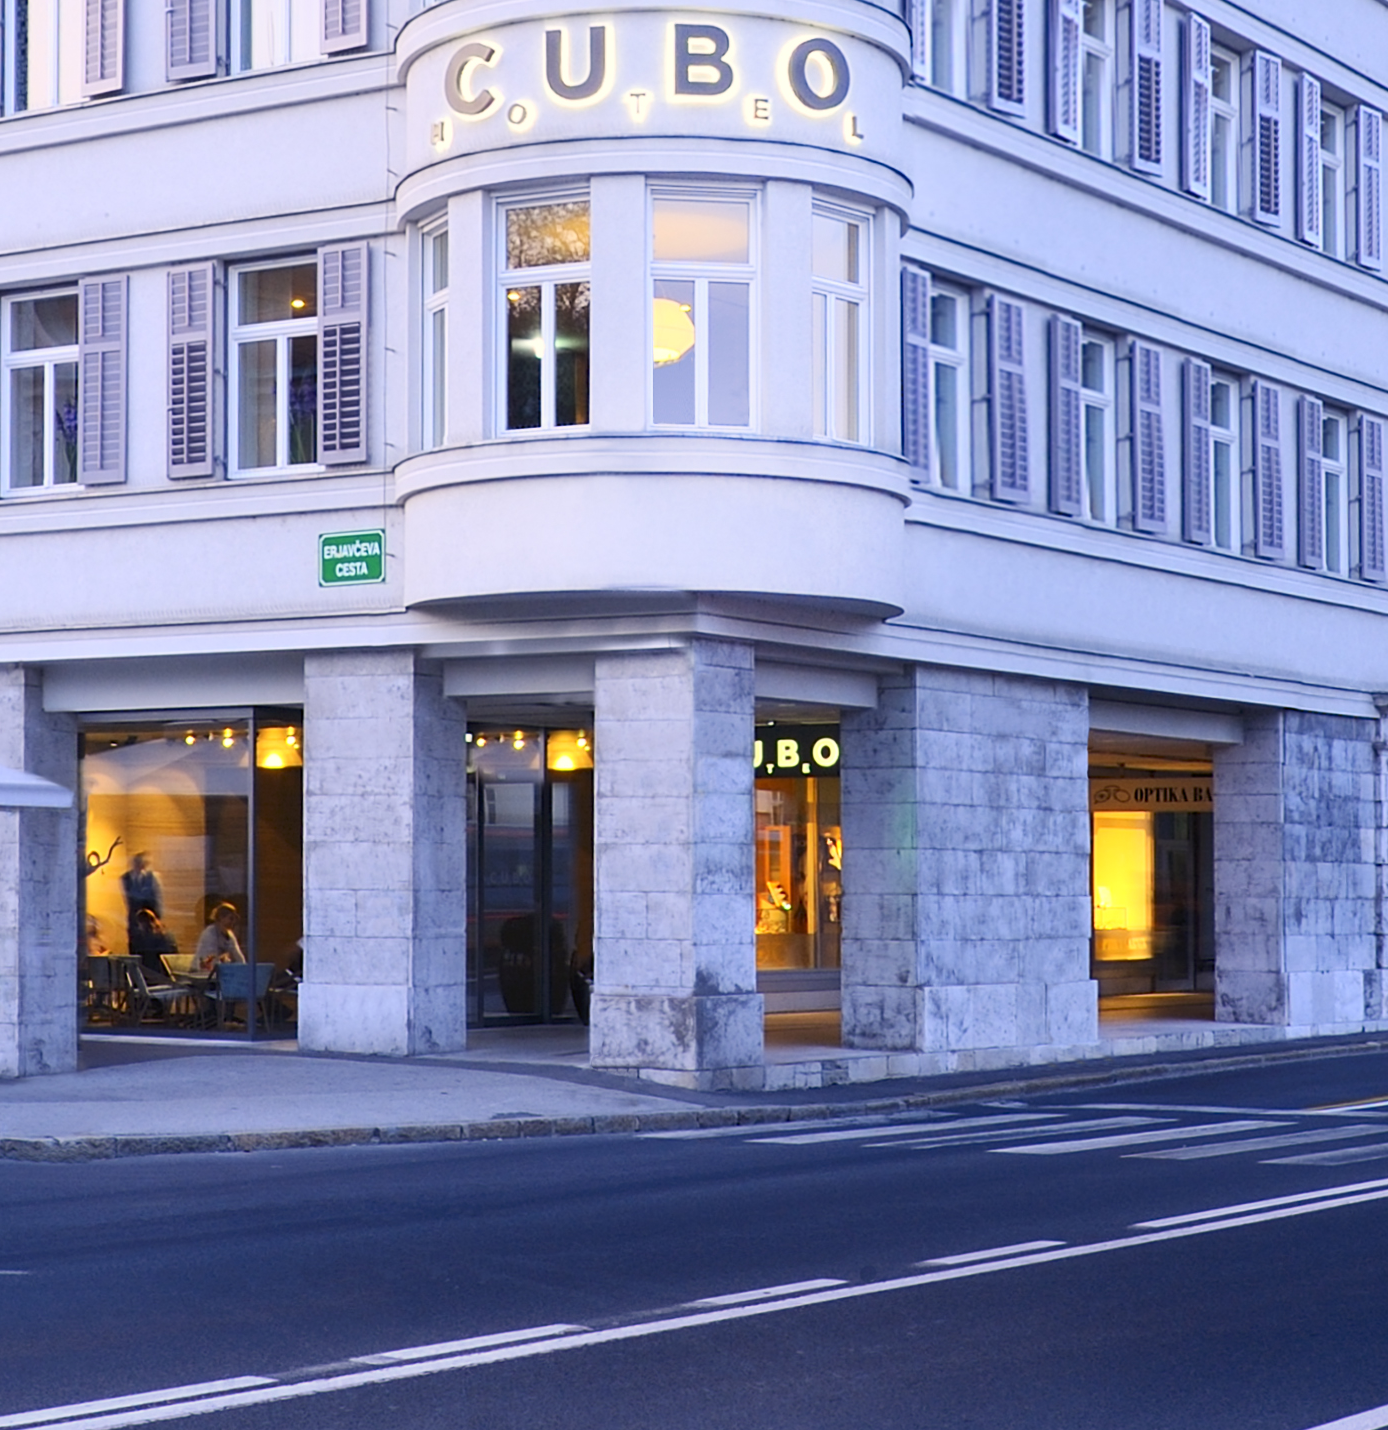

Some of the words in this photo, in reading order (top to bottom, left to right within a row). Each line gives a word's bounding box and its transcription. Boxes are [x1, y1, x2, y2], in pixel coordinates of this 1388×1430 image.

[444, 24, 851, 115] CUBO
[430, 92, 865, 145] HOTEL
[324, 540, 380, 559] ERJAVČEVA
[335, 562, 368, 577] CESTA
[1134, 787, 1188, 802] OPTIKA
